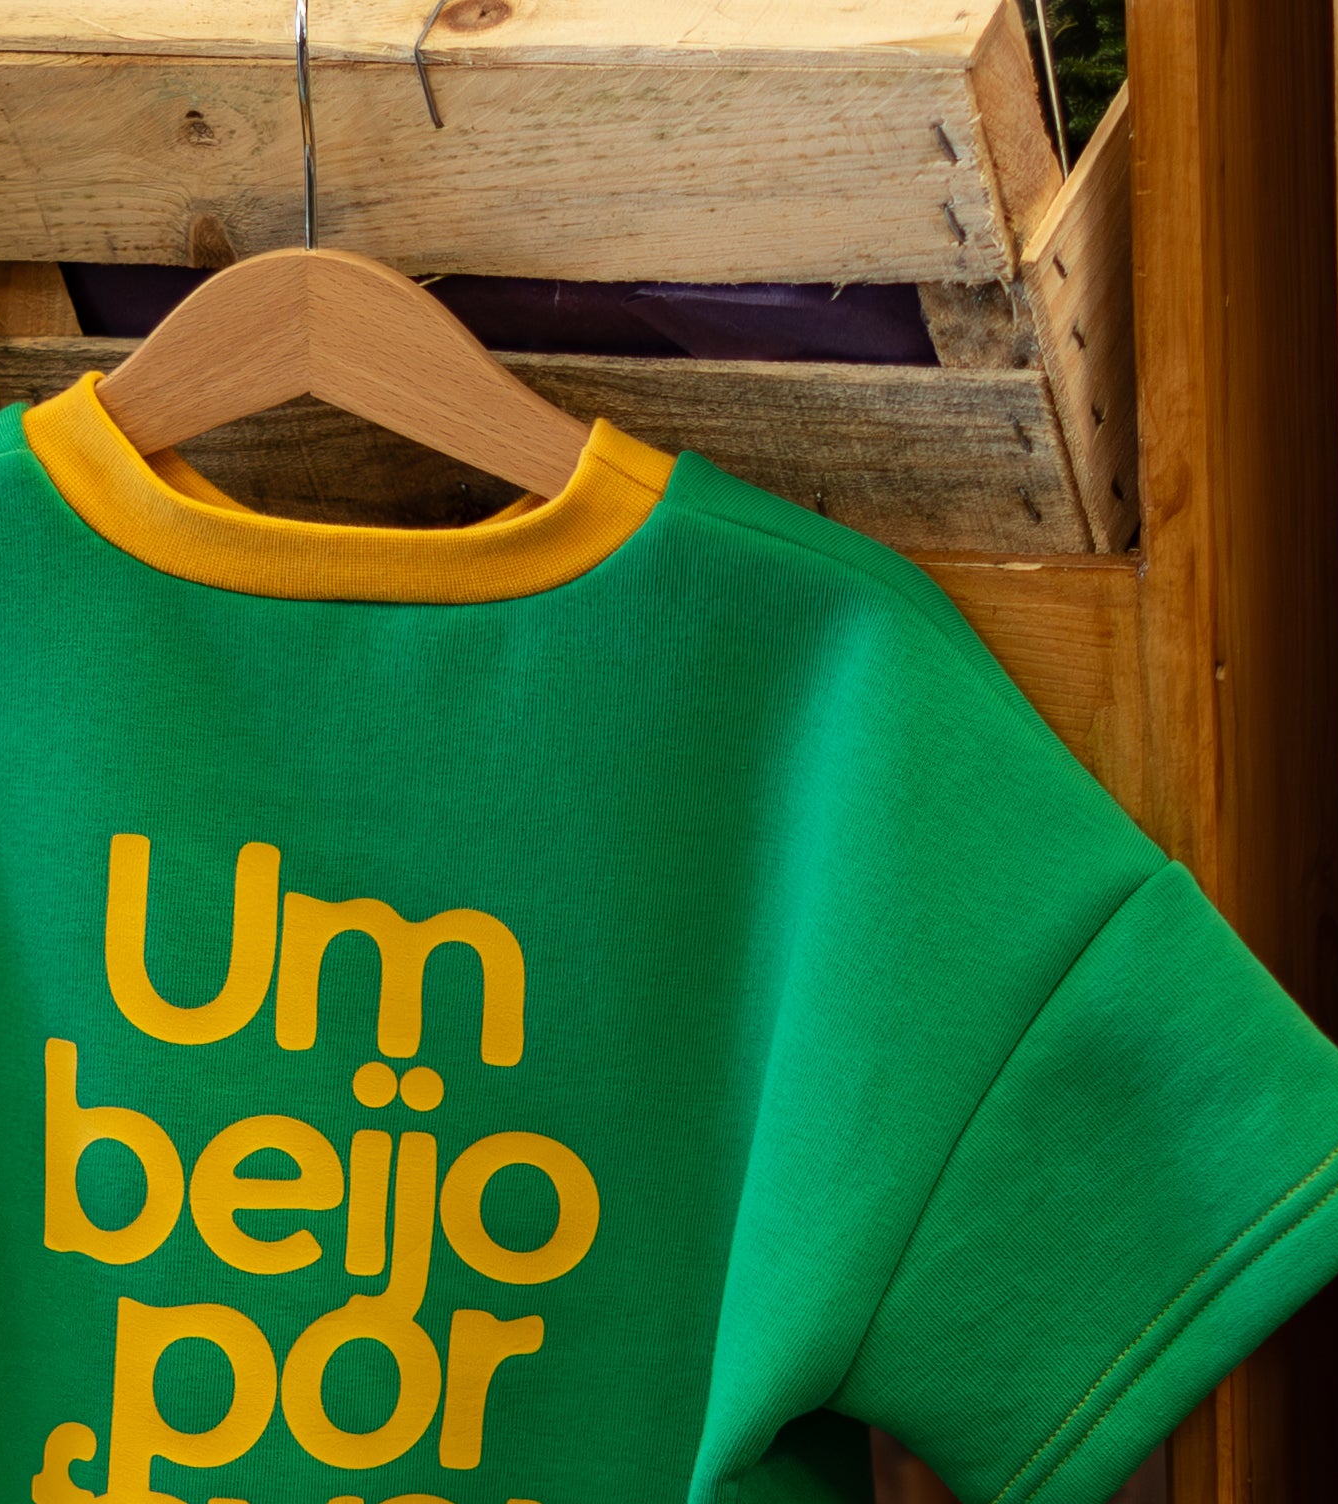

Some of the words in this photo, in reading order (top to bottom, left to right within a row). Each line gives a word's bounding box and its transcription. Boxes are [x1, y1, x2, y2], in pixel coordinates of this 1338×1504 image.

[104, 832, 526, 1067] Um
[44, 1037, 601, 1320] beijo
[106, 1295, 545, 1500] por
